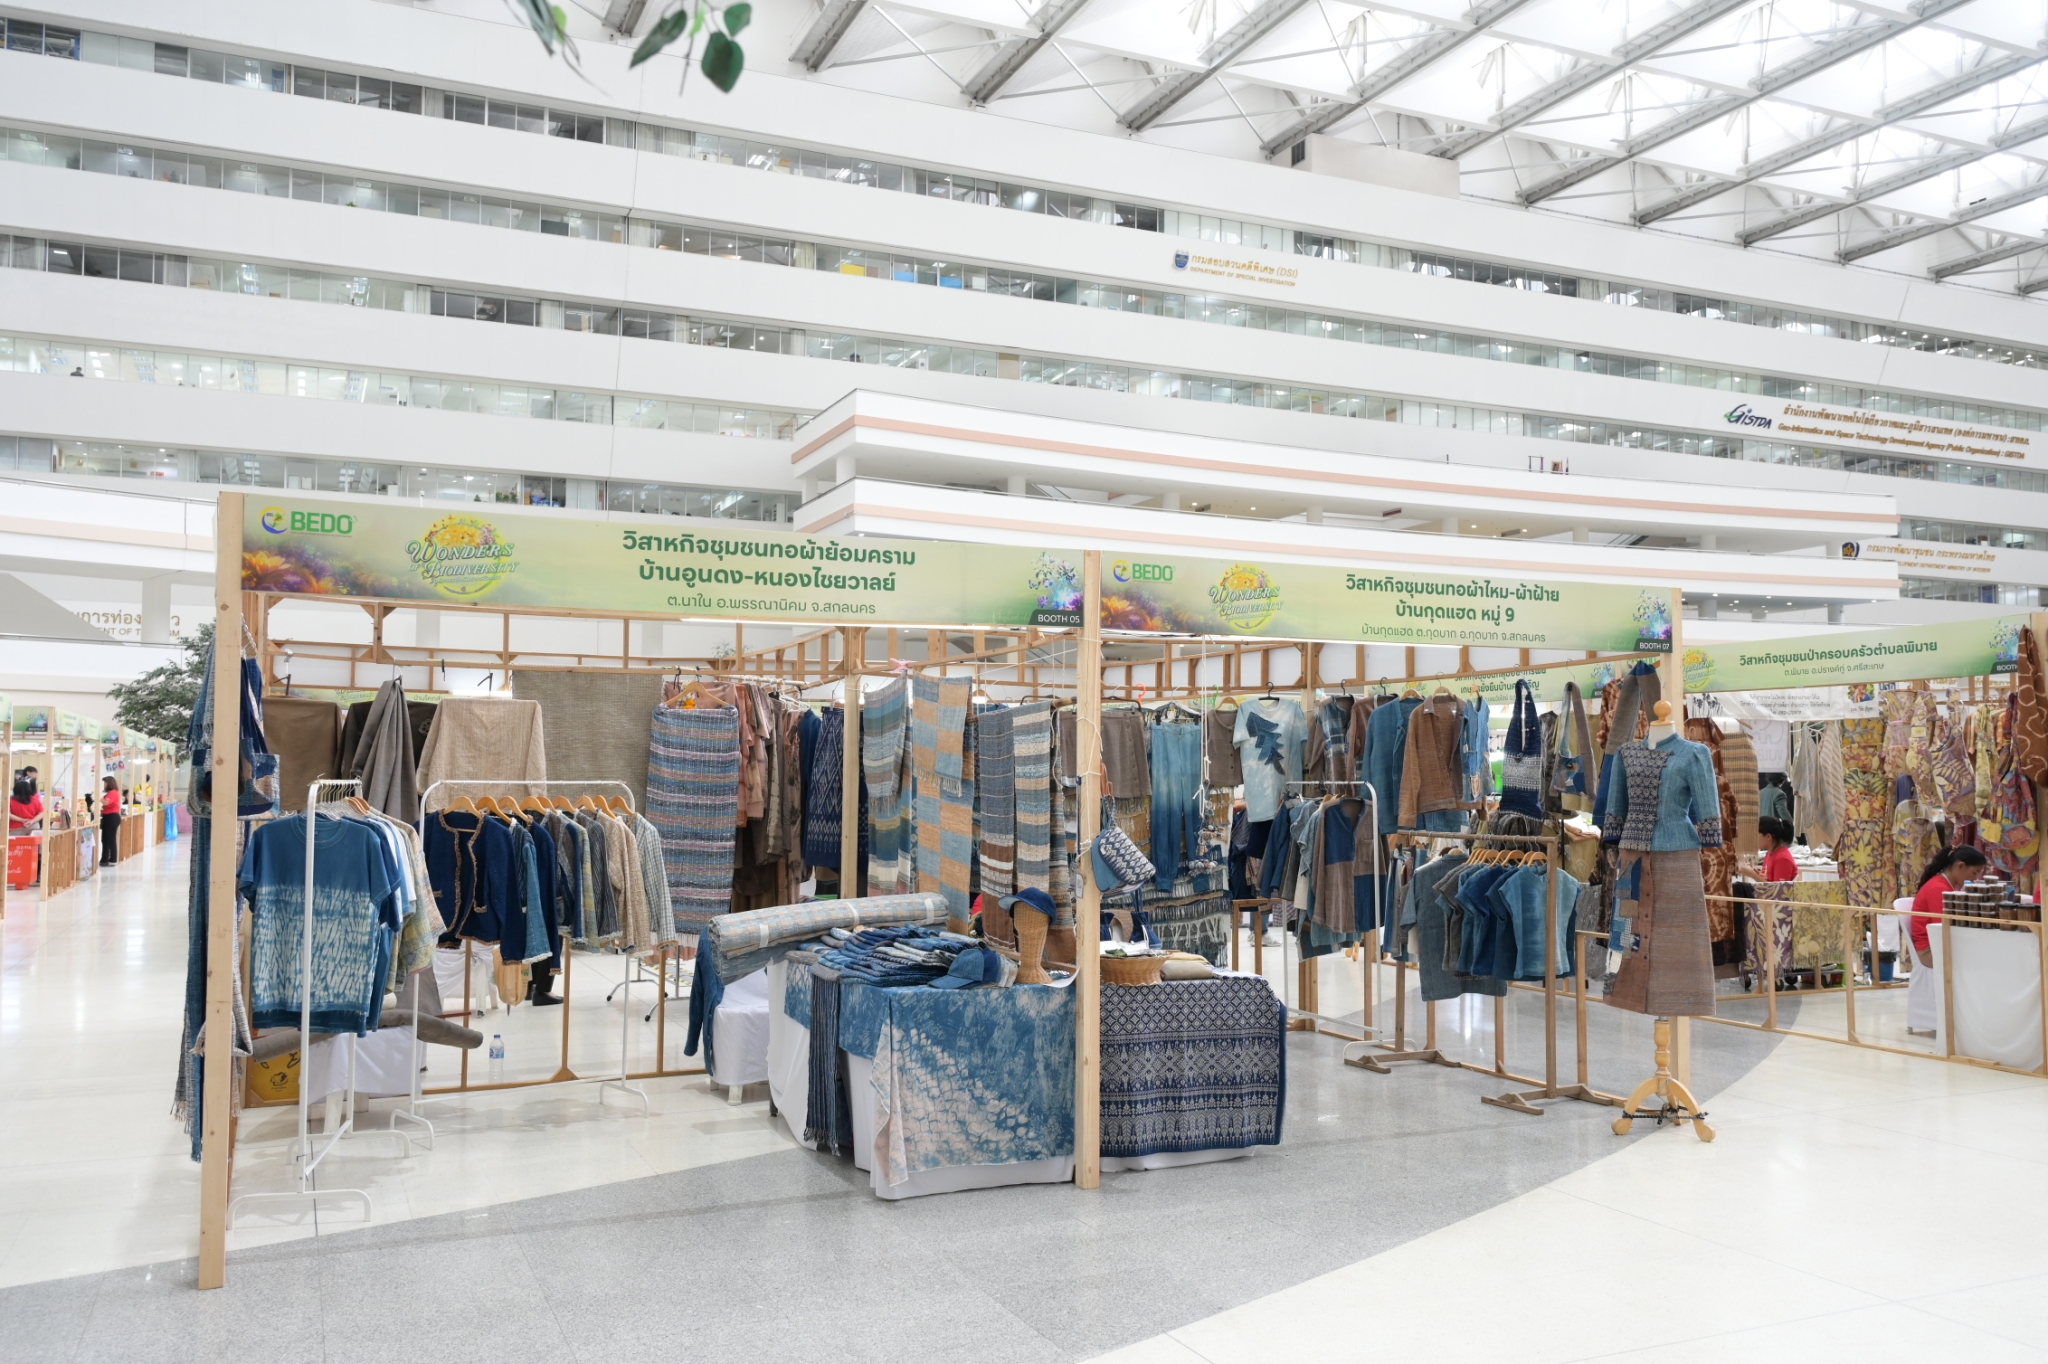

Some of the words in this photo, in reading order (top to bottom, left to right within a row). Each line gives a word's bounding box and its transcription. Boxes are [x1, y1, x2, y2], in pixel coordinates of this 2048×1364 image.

[1190, 266, 1226, 276] DEPARTMENT
[1235, 273, 1257, 281] SPECIAL
[1258, 277, 1296, 287] INVESTIGATION
[1276, 266, 1298, 279] (DSI)
[1777, 422, 1823, 435] Geo-Informatics
[1824, 428, 1837, 436] and
[1836, 430, 1855, 439] Space
[1855, 432, 1889, 444] Technology
[1889, 436, 1925, 447] Development
[1925, 441, 1946, 451] Agency
[1946, 443, 1966, 453] (Public
[1965, 445, 2001, 458] Organization)
[2004, 451, 2026, 460] GISTDA
[290, 510, 354, 535] BEDO
[405, 539, 515, 563] WONDERS
[622, 530, 916, 566] วิสาหกิจชุมชนทอผ้าย้อมคราม
[421, 560, 521, 580] BIODIVERSITY
[639, 558, 896, 592] บ้านอูนดง-หนองไชยวาลย์
[1132, 563, 1174, 582] BEDO
[1208, 585, 1281, 604] WONDERS
[1346, 573, 1560, 602] วิสาหกิจชุมชนทอผ้าไหม-ผ้าฝ้าย
[667, 592, 712, 608] ต.นาใน
[716, 597, 807, 612] อ.พรรณานิคม
[811, 602, 876, 614] จ.สกลนคร
[1219, 601, 1284, 616] BIODIVERSITY
[1395, 599, 1477, 624] บ้านกุดแฮด
[1481, 605, 1501, 626] หมู่
[1505, 607, 1515, 622] 9
[1037, 614, 1068, 623] BOOTH
[1069, 615, 1080, 623] 05
[119, 627, 133, 636] OF
[1361, 623, 1414, 637] บ้านกุดแฮด
[1416, 628, 1456, 640] ต.กุดบาก
[1459, 630, 1499, 642] อ.กุดบาก
[1501, 632, 1546, 643] จ.สกลนคร
[1639, 642, 1661, 650] BOOTH
[1739, 640, 1938, 667] วิสาหกิจชุมชนป่าครอบครัวตำบลพิมาย
[1784, 667, 1810, 677] ต.พิมาย
[1846, 661, 1885, 673] จ.ศรีสะเกษ
